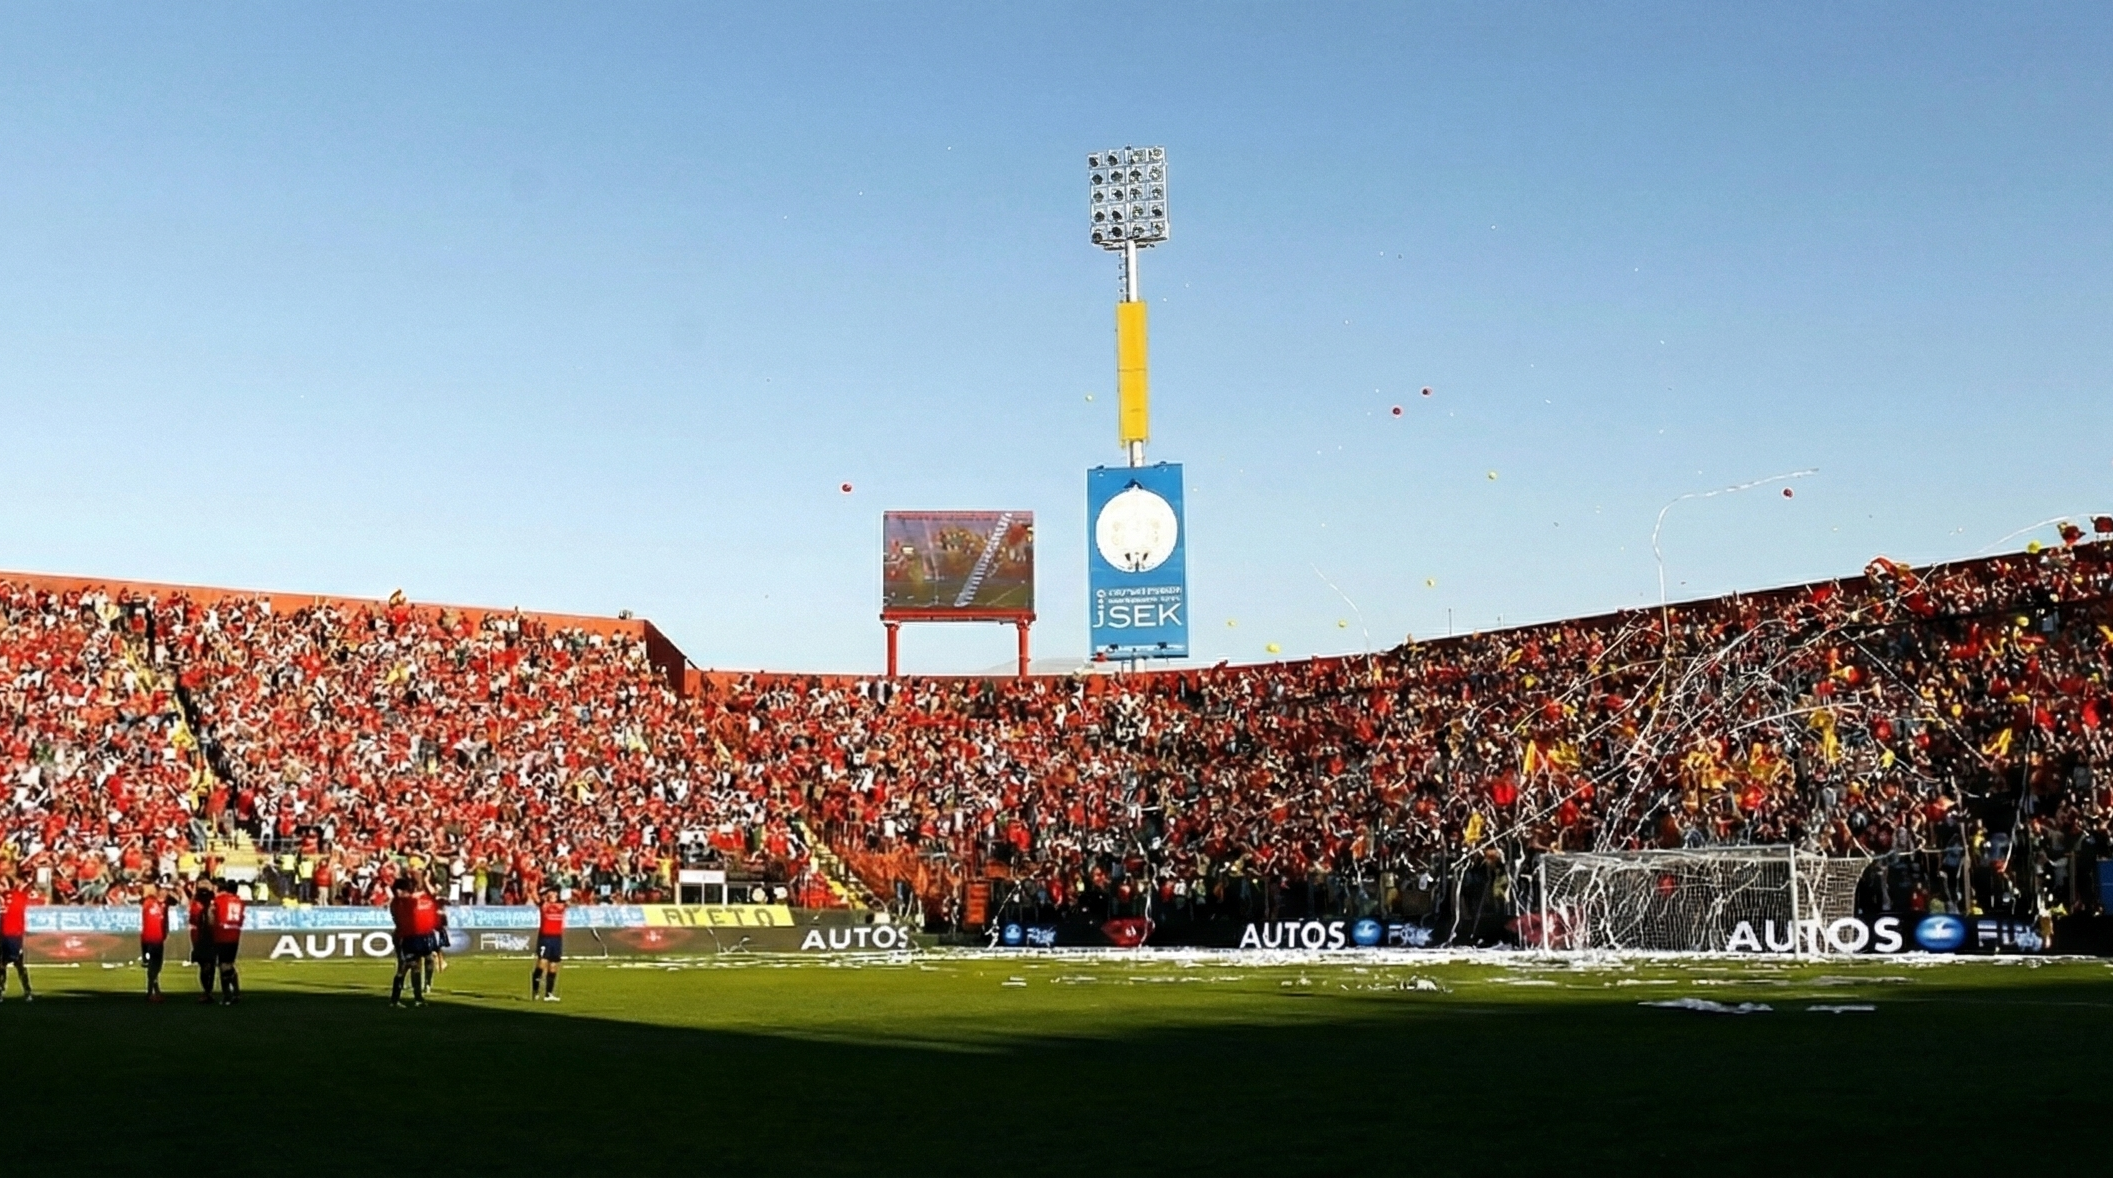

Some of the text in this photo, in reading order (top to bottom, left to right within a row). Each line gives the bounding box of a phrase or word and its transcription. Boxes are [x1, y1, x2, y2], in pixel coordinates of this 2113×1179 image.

[270, 932, 395, 959] AUTO
[801, 926, 909, 950] AUTOS
[1239, 921, 1345, 949] AUTOS
[1726, 917, 1903, 953] AUTOS
